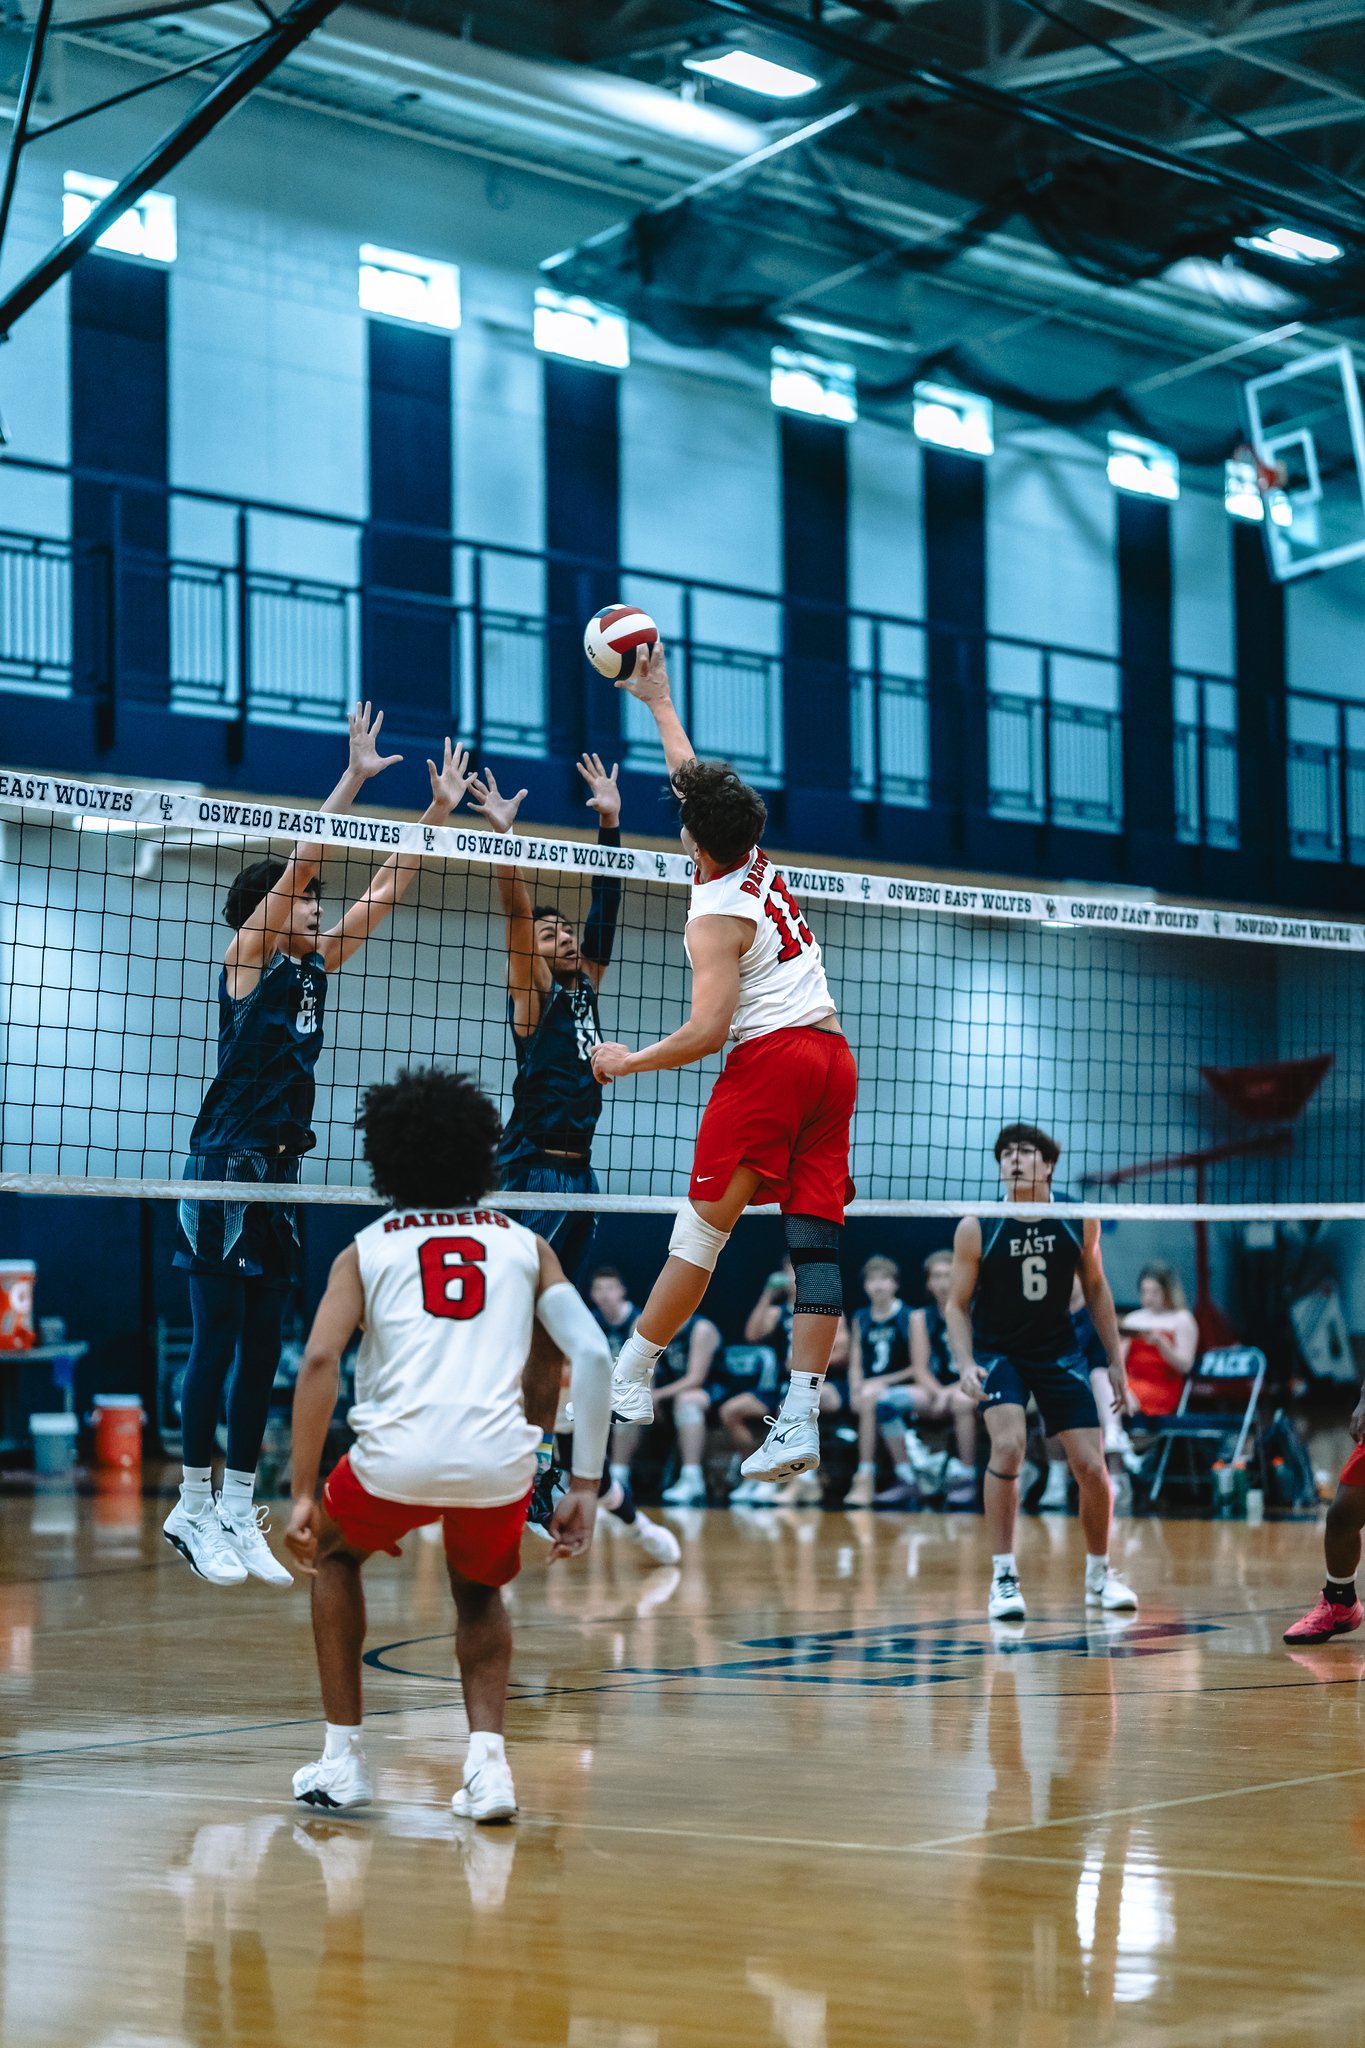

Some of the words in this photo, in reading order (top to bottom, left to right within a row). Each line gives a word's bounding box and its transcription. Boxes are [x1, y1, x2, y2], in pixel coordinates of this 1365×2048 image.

[0, 776, 49, 800] EAST
[54, 784, 133, 812] WOLVES
[199, 802, 272, 828] OSWEGO
[277, 812, 326, 835] EAST
[331, 819, 401, 844] WOLVES
[456, 834, 522, 858] OSWEGO
[528, 842, 568, 863] EAST
[573, 847, 635, 870] WOLVES
[789, 870, 845, 893] WOLVES
[888, 883, 940, 904] OSWEGO
[944, 890, 978, 908] EAST
[981, 893, 1032, 913] WOLVES
[1070, 902, 1119, 922] OSWEGO
[1121, 905, 1152, 926] EAST
[1153, 910, 1200, 930] WOLVES
[384, 1210, 511, 1233] RAIDERS
[1010, 1234, 1056, 1257] EAST
[418, 1236, 487, 1321] 6
[1022, 1255, 1048, 1301] 6
